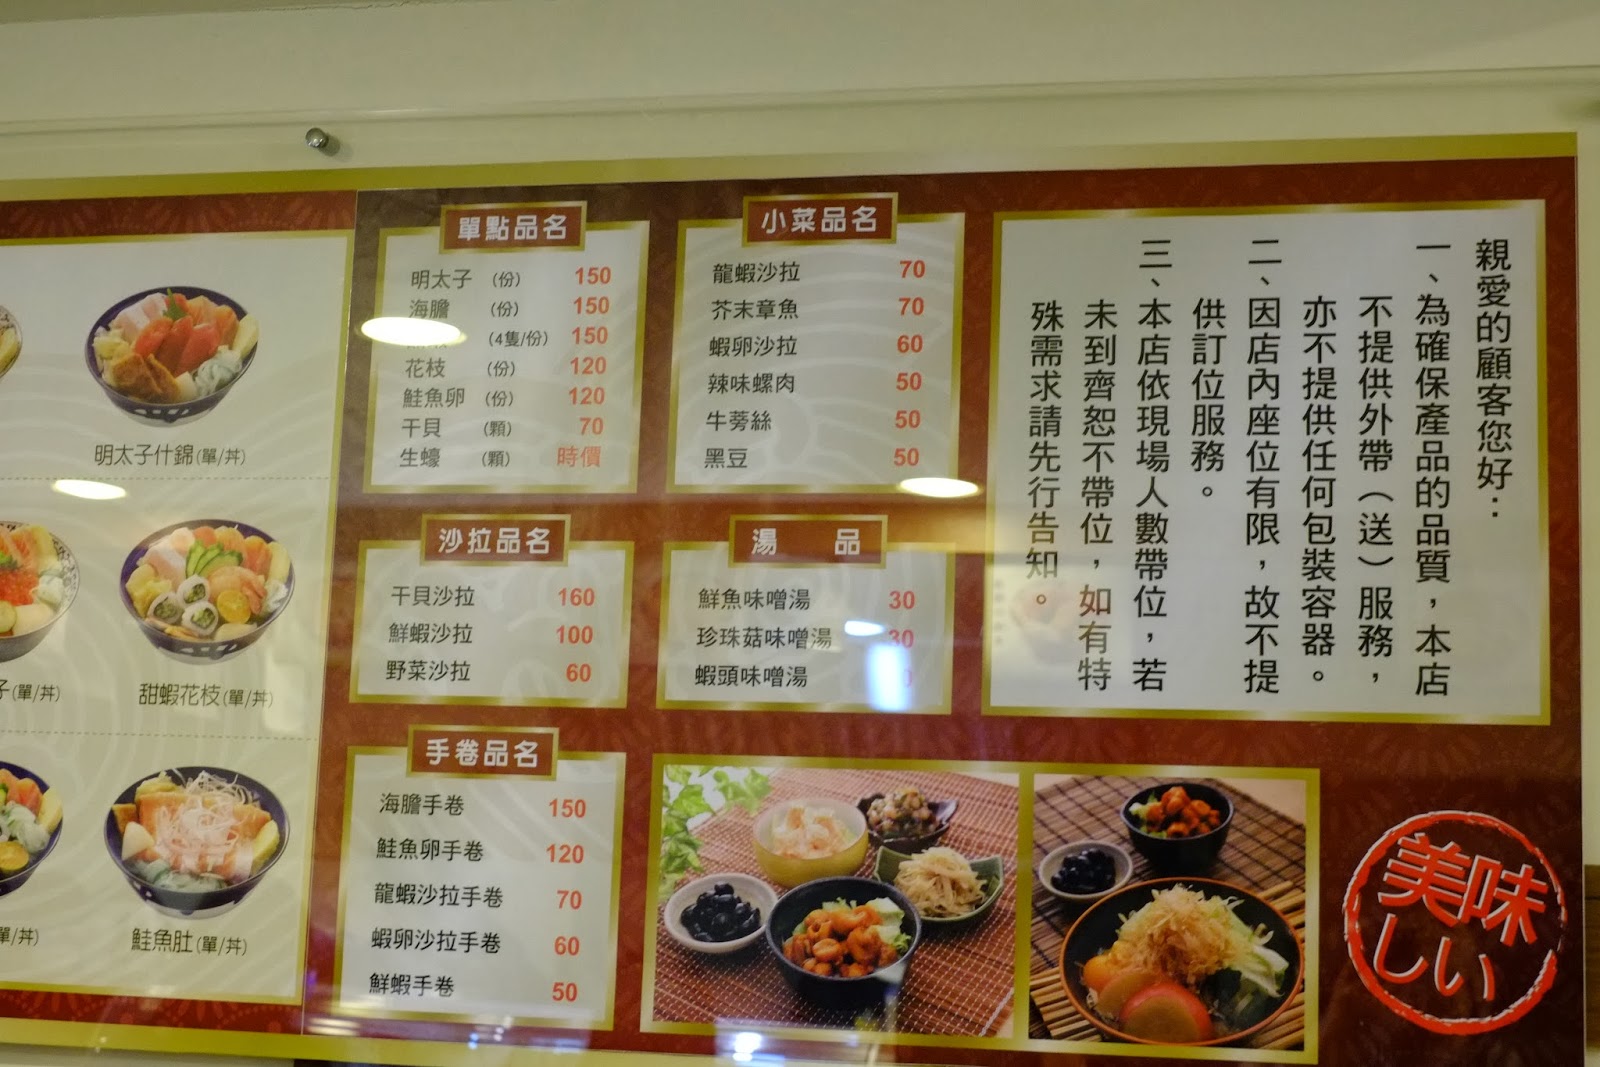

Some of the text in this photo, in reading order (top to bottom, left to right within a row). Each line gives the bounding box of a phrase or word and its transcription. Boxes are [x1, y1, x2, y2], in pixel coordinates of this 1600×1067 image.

[458, 214, 567, 241] 單點品名
[761, 205, 877, 234] 小菜品名
[411, 266, 611, 290] 明太子 (份) 150
[713, 260, 925, 283] 龍蝦沙拉 70
[409, 297, 609, 319] 海膽 (份) 150
[711, 297, 924, 320] 芥末章魚 70
[572, 327, 608, 345] 150
[709, 335, 923, 357] 蝦卵沙拉 60
[405, 357, 606, 378] 花枝 (份) 120
[707, 372, 922, 394] 辣味螺肉 50
[402, 387, 605, 408] 鮭魚卵 (份) 120
[1191, 297, 1227, 498] 供訂位服務。
[401, 417, 441, 438] 干貝
[579, 417, 604, 435] 70
[706, 410, 921, 431] 牛蒡絲 50
[400, 448, 440, 468] 生蠔
[557, 446, 601, 467] 時價
[704, 448, 919, 469] 黑豆 50
[438, 527, 550, 554] 沙拉品名
[752, 528, 860, 556] 湯 品
[391, 585, 595, 607] 干貝沙拉 160
[698, 588, 915, 610] 鮮魚味噌湯 30
[389, 623, 593, 644] 鮮蝦沙拉 100
[697, 626, 832, 649] 珍珠菇味噌湯
[386, 660, 591, 682] 野菜沙拉 60
[695, 665, 808, 688] 蝦頭味噌湯
[426, 738, 538, 768] 手卷品名
[379, 792, 586, 818] 海膽手卷 150
[376, 837, 584, 864] 鮭魚卵手卷 120
[374, 882, 582, 909] 龍蝦沙拉手卷 70
[1378, 832, 1548, 947] 美味
[371, 927, 580, 956] 蝦卵沙拉手卷 60
[1374, 913, 1495, 1001] しい
[369, 972, 578, 1002] 鮮蝦手卷 50
